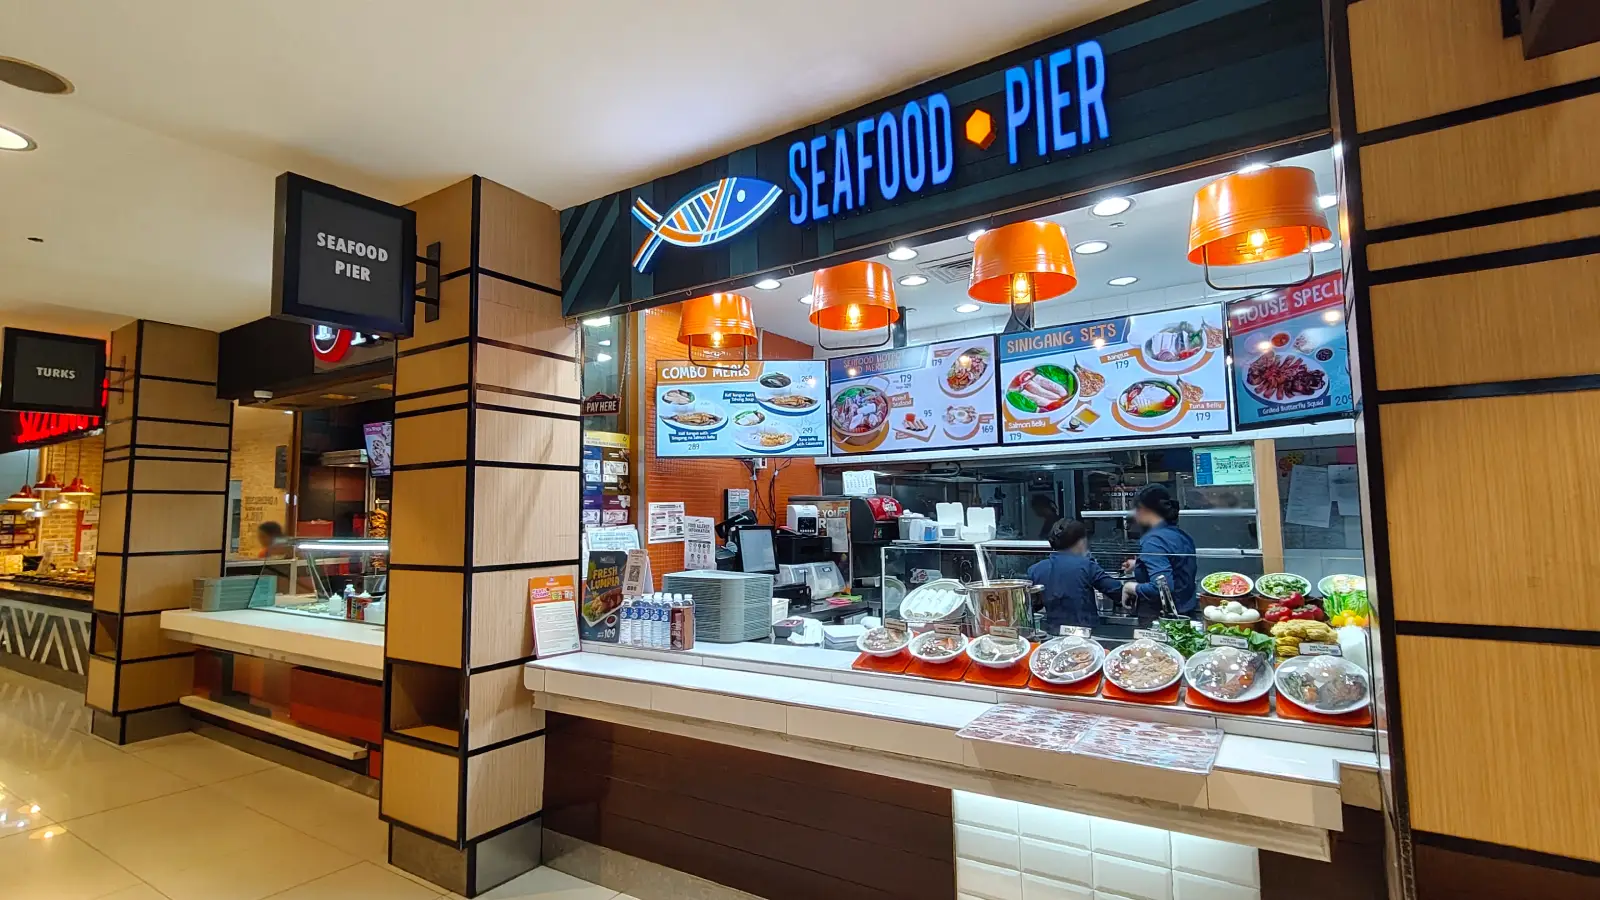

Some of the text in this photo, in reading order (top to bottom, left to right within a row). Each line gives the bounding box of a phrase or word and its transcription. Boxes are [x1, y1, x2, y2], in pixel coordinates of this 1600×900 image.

[788, 39, 1110, 226] SEAFOOD PIER
[316, 231, 389, 262] SEAFOOD
[335, 260, 371, 282] PIER
[1236, 295, 1289, 326] HOUSE
[1006, 322, 1117, 354] SINIGANG SETS
[1115, 359, 1130, 370] 179
[36, 366, 76, 380] TURKS
[661, 363, 750, 380] COMBO MEALS
[899, 373, 912, 384] 179
[586, 400, 617, 413] PAY HERE
[923, 409, 933, 418] 95
[1196, 411, 1211, 421] 179
[981, 424, 994, 434] 169
[1008, 421, 1030, 429] Salmon
[1009, 432, 1022, 441] 179
[687, 442, 700, 451] 289
[593, 565, 618, 579] FRESH
[591, 575, 620, 590] LUMPIA
[604, 627, 616, 639] 109
